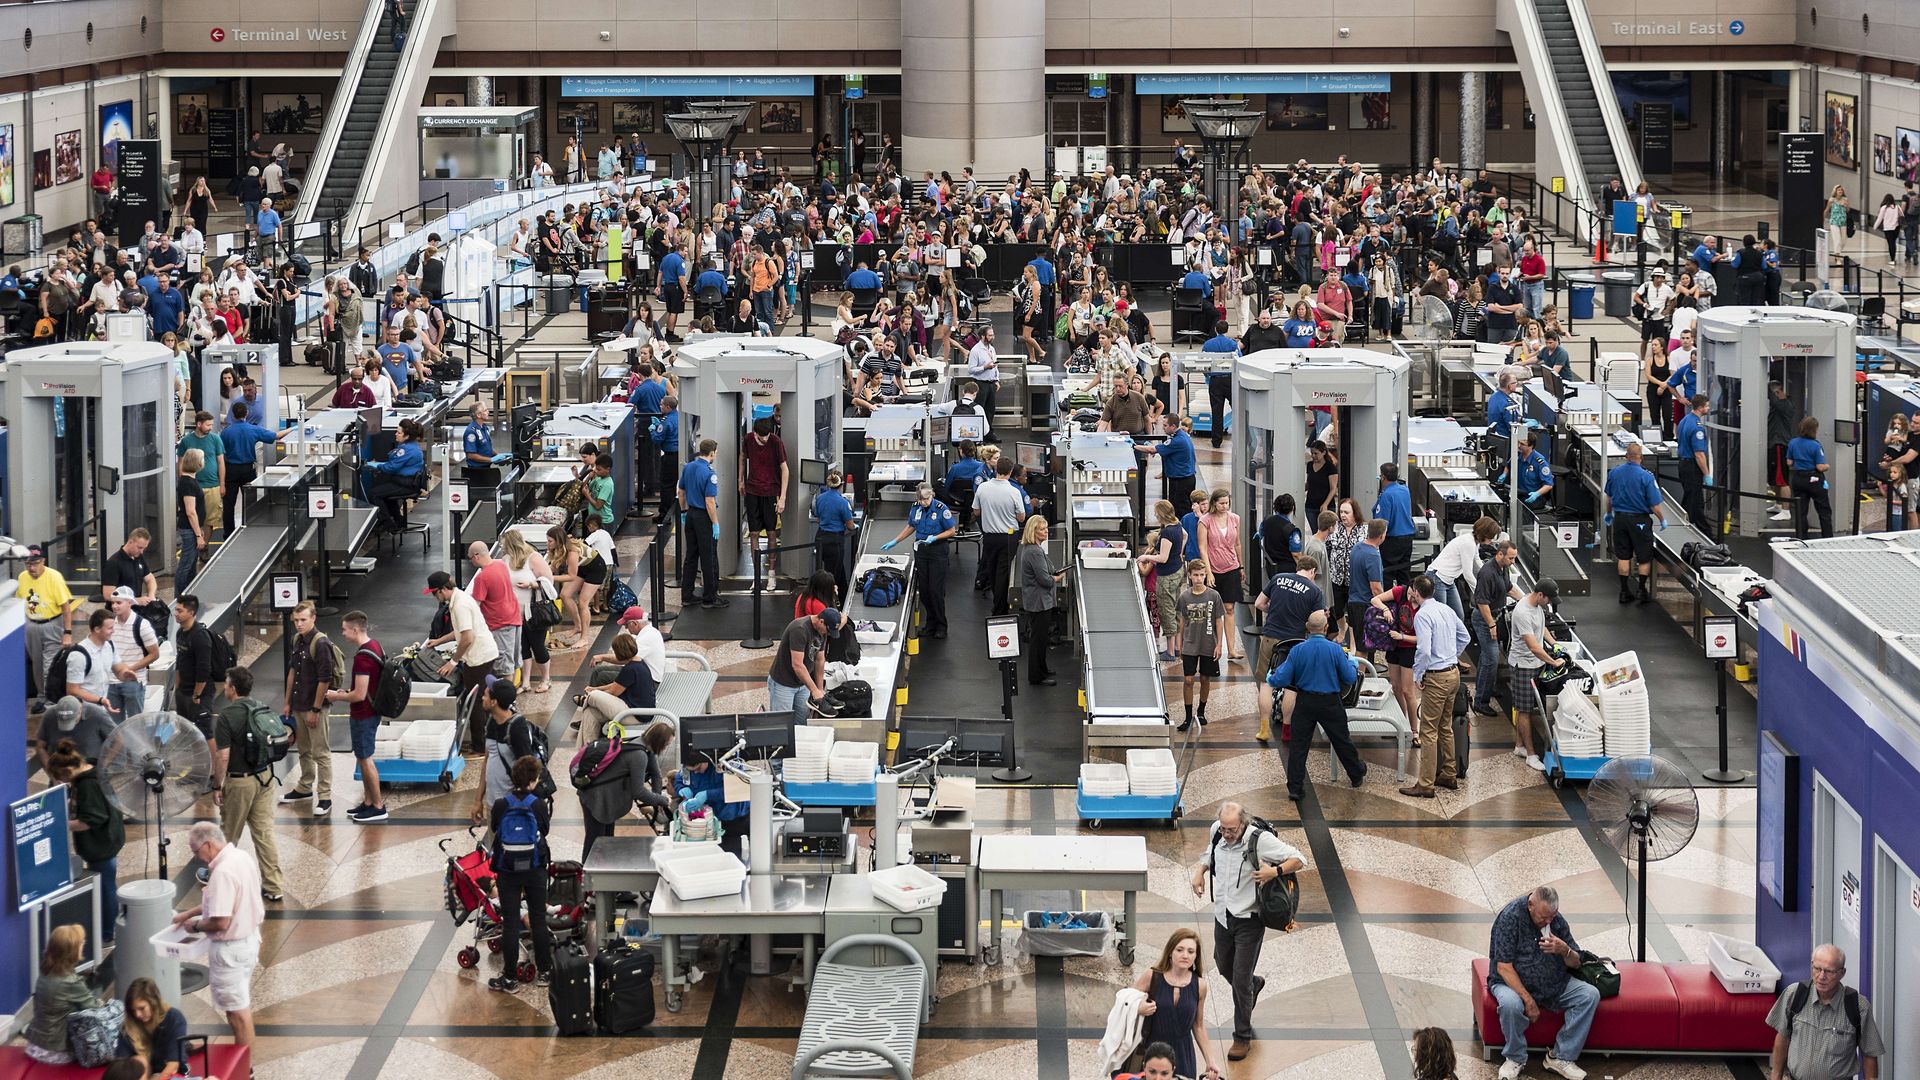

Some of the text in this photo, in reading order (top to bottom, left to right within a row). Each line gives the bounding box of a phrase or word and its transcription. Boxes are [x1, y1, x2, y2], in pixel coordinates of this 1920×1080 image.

[232, 27, 347, 41] Terminal West
[1612, 21, 1723, 35] Terminal East
[249, 352, 258, 362] 2
[1277, 577, 1310, 593] CAPE MAY
[15, 806, 27, 817] TSA
